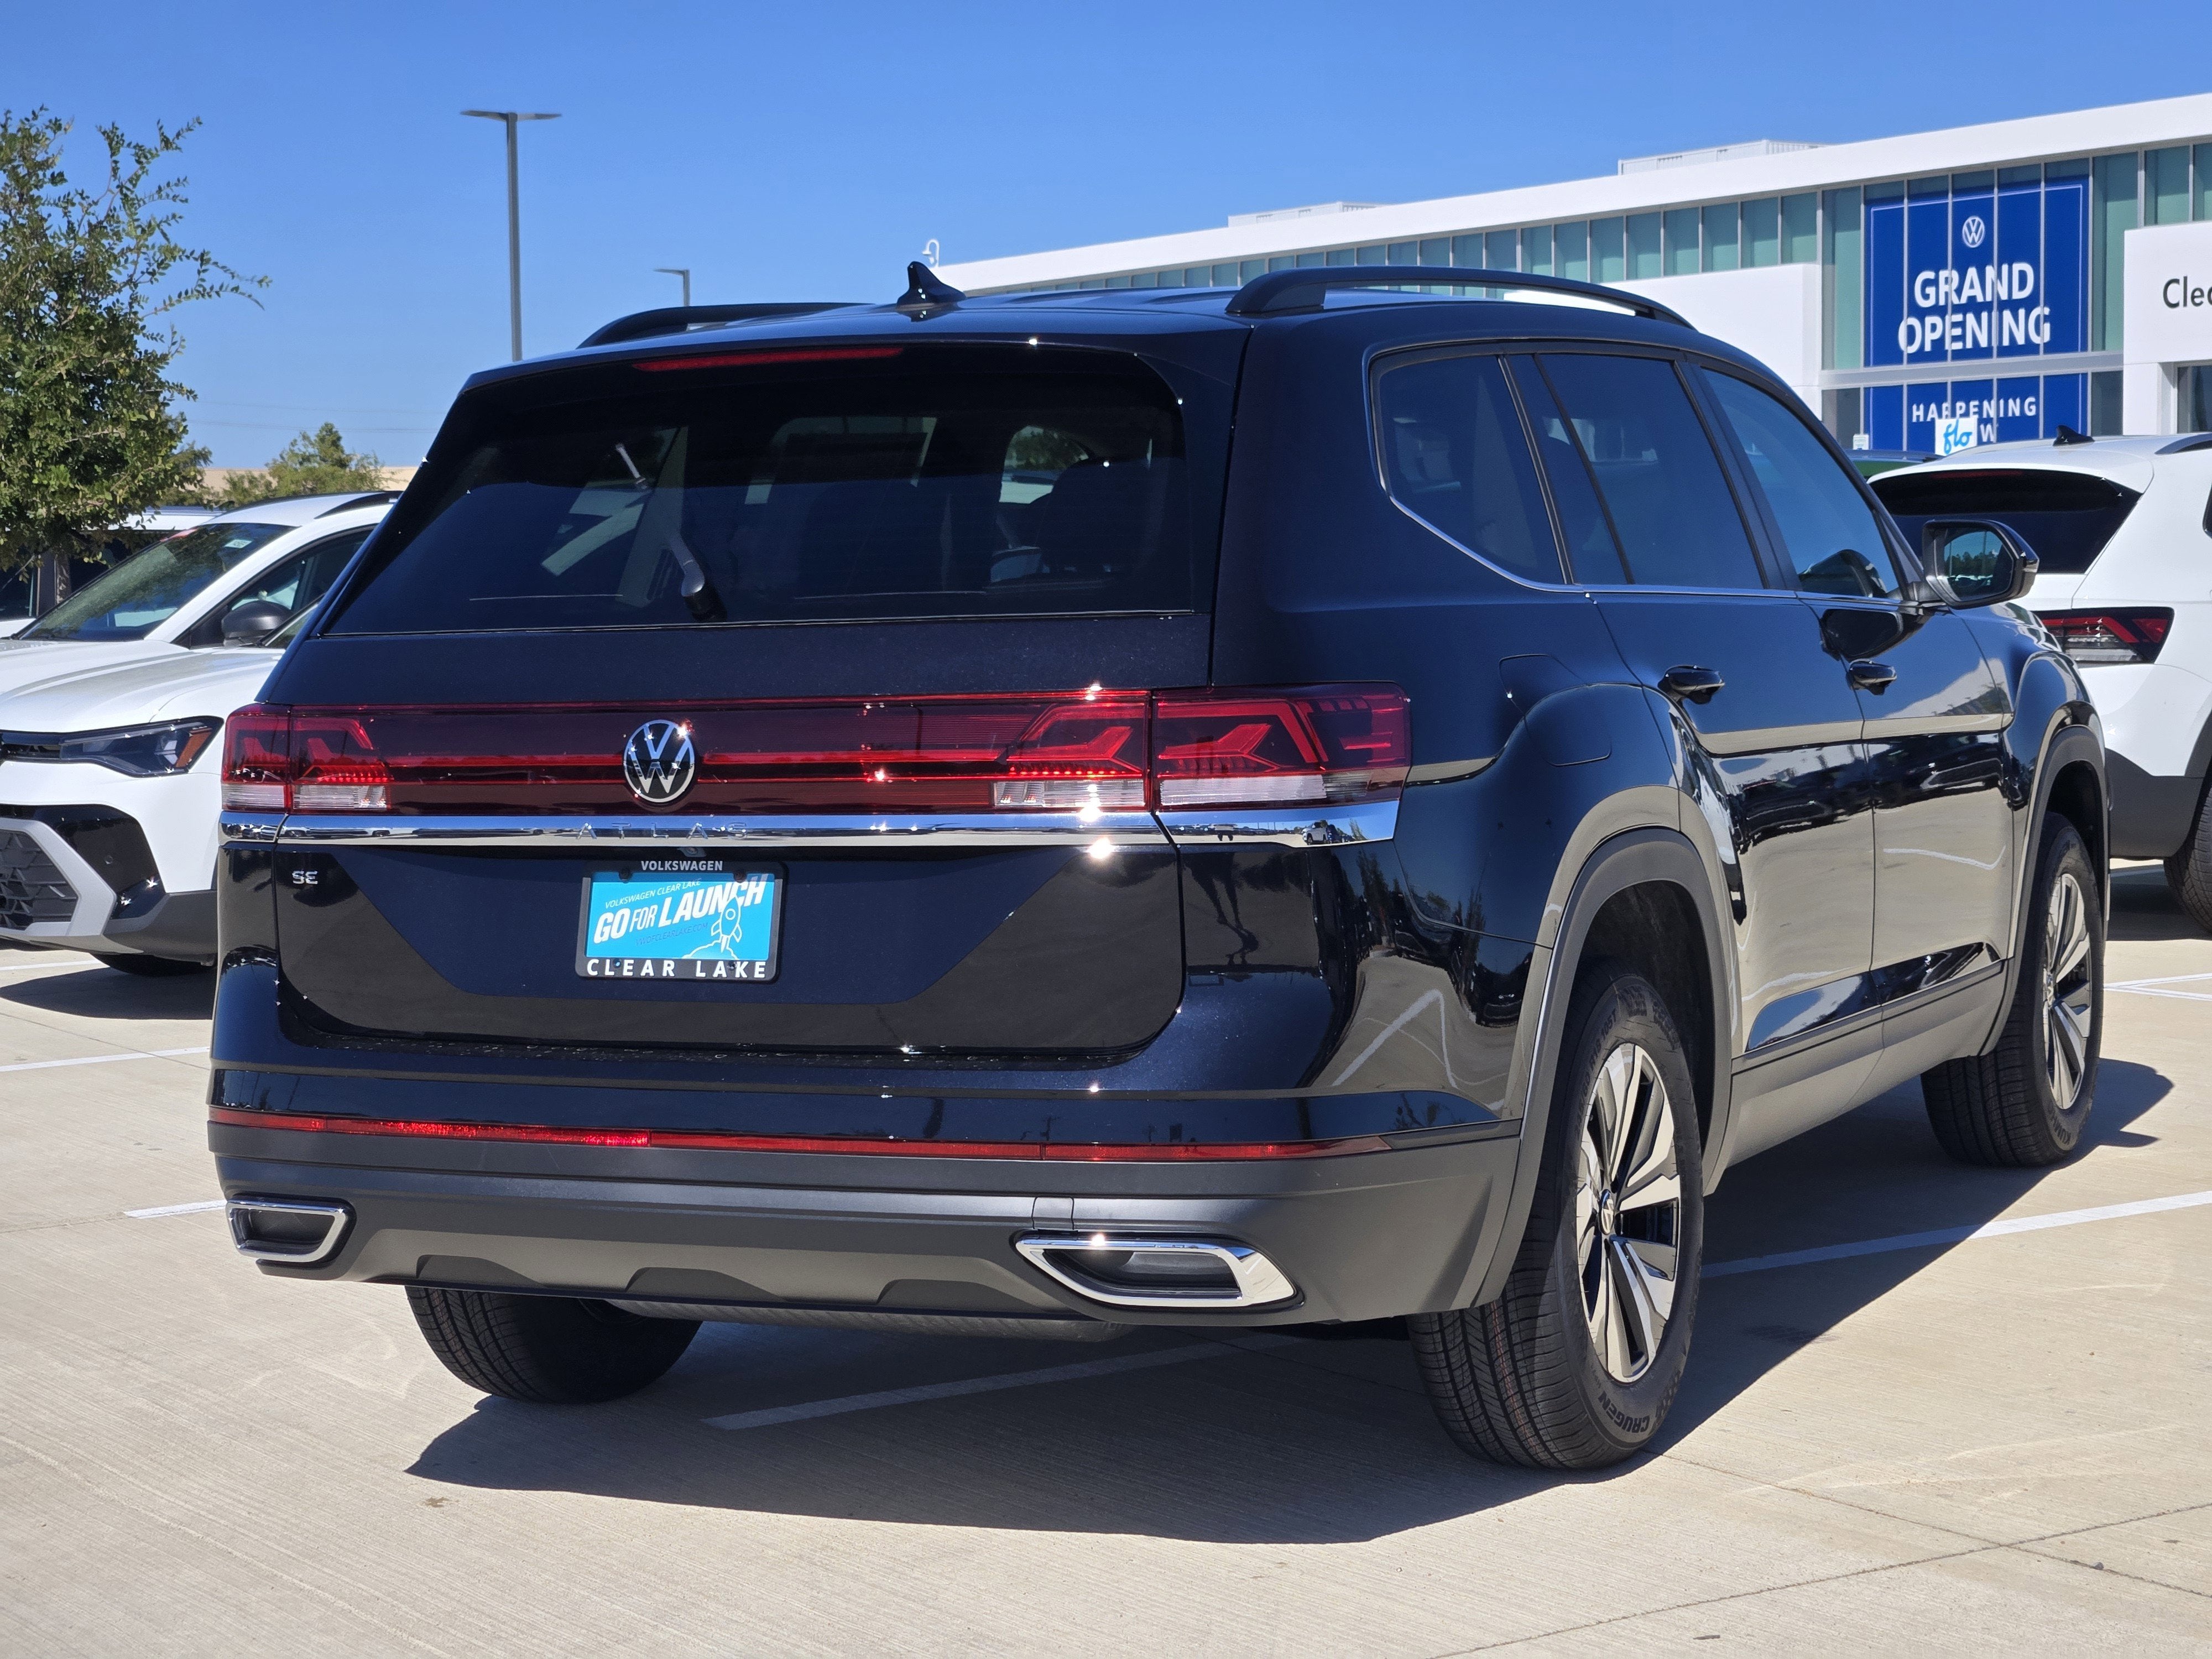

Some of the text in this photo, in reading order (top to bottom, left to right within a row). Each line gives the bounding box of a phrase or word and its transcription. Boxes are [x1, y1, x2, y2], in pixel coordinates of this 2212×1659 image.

[1914, 263, 2034, 307] GRAND
[1898, 307, 2050, 353] OPENING
[1943, 419, 1973, 455] flo
[576, 822, 747, 839] ATLAS
[291, 870, 319, 885] SE
[641, 860, 723, 871] VOLKSWAGEN
[593, 874, 769, 944] GO FOR LAUNCH
[605, 878, 702, 909] VOLKSWAGEN CLEAR LAKE
[587, 959, 766, 978] CLEAR LAKE
[1598, 1391, 1650, 1433] CRUGEN
